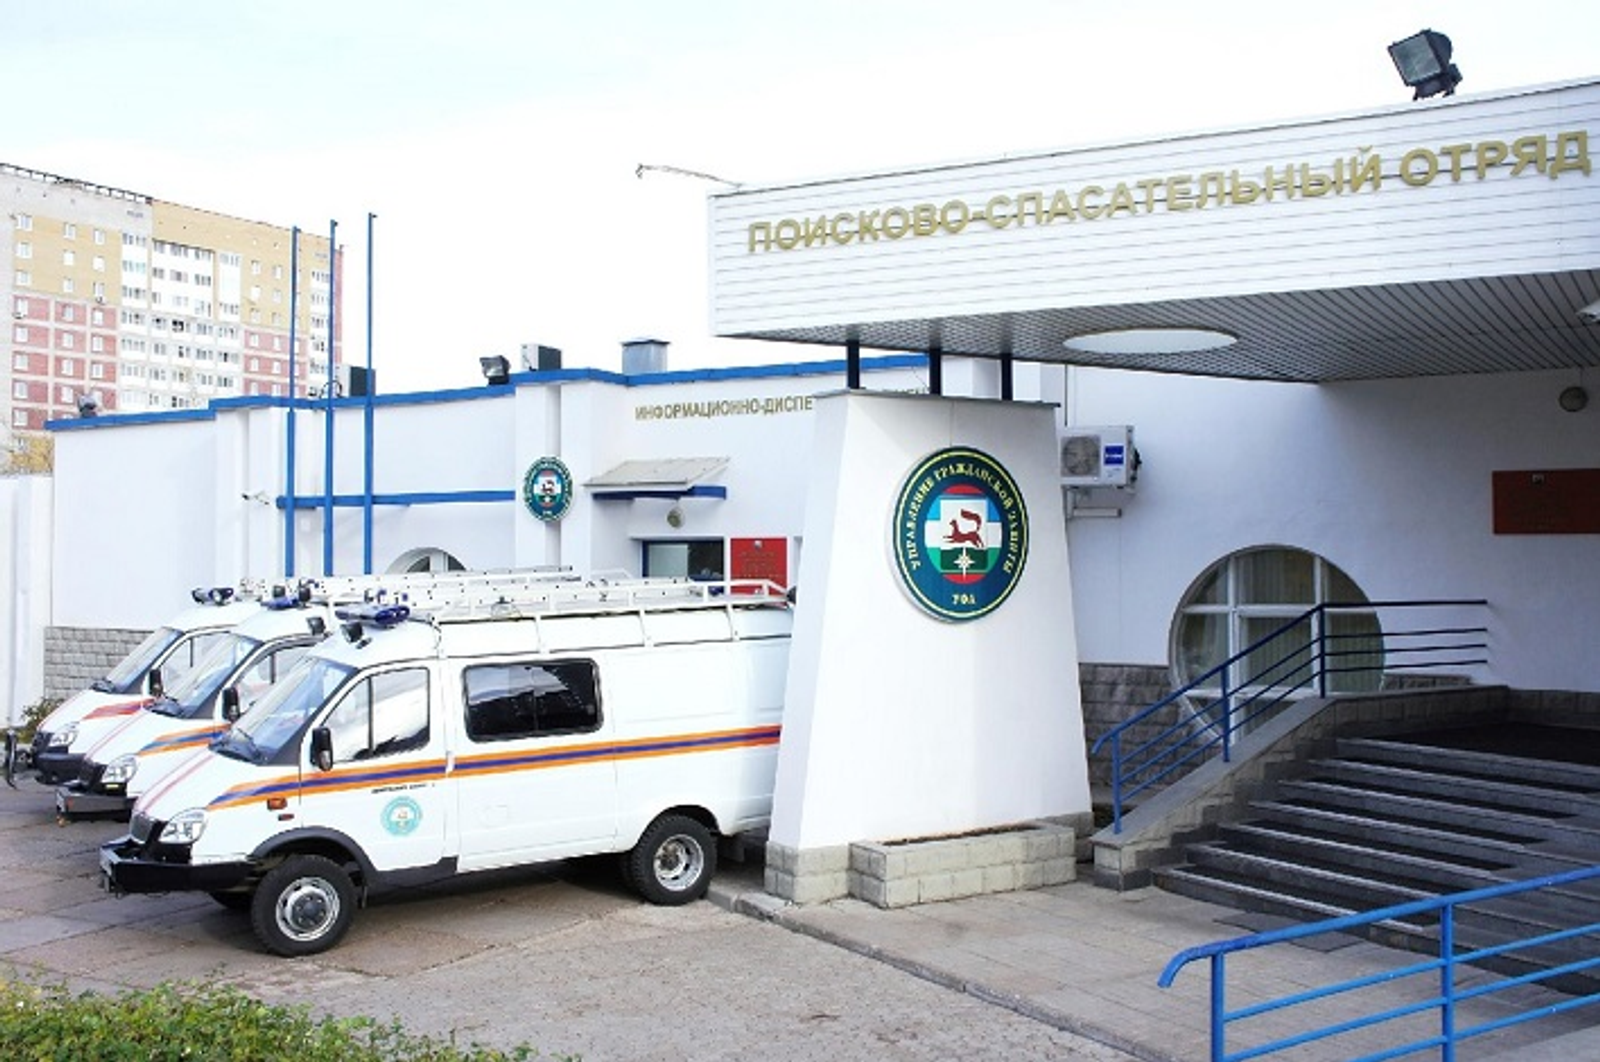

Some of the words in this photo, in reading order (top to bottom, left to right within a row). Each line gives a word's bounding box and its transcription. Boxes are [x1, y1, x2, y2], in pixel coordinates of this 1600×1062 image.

[748, 145, 1381, 253] ПОИСКОВО-СПАСАТЕЛЬНЫЙ
[1399, 130, 1592, 187] ОТРЯД
[635, 395, 813, 420] ИНФОРМАЦИОННО-ДИСПЕ
[906, 477, 935, 571] УПРАВЛЕНИЕ
[933, 463, 1014, 510] ГРАЖДАНСКОЙ
[951, 593, 977, 606] УФА
